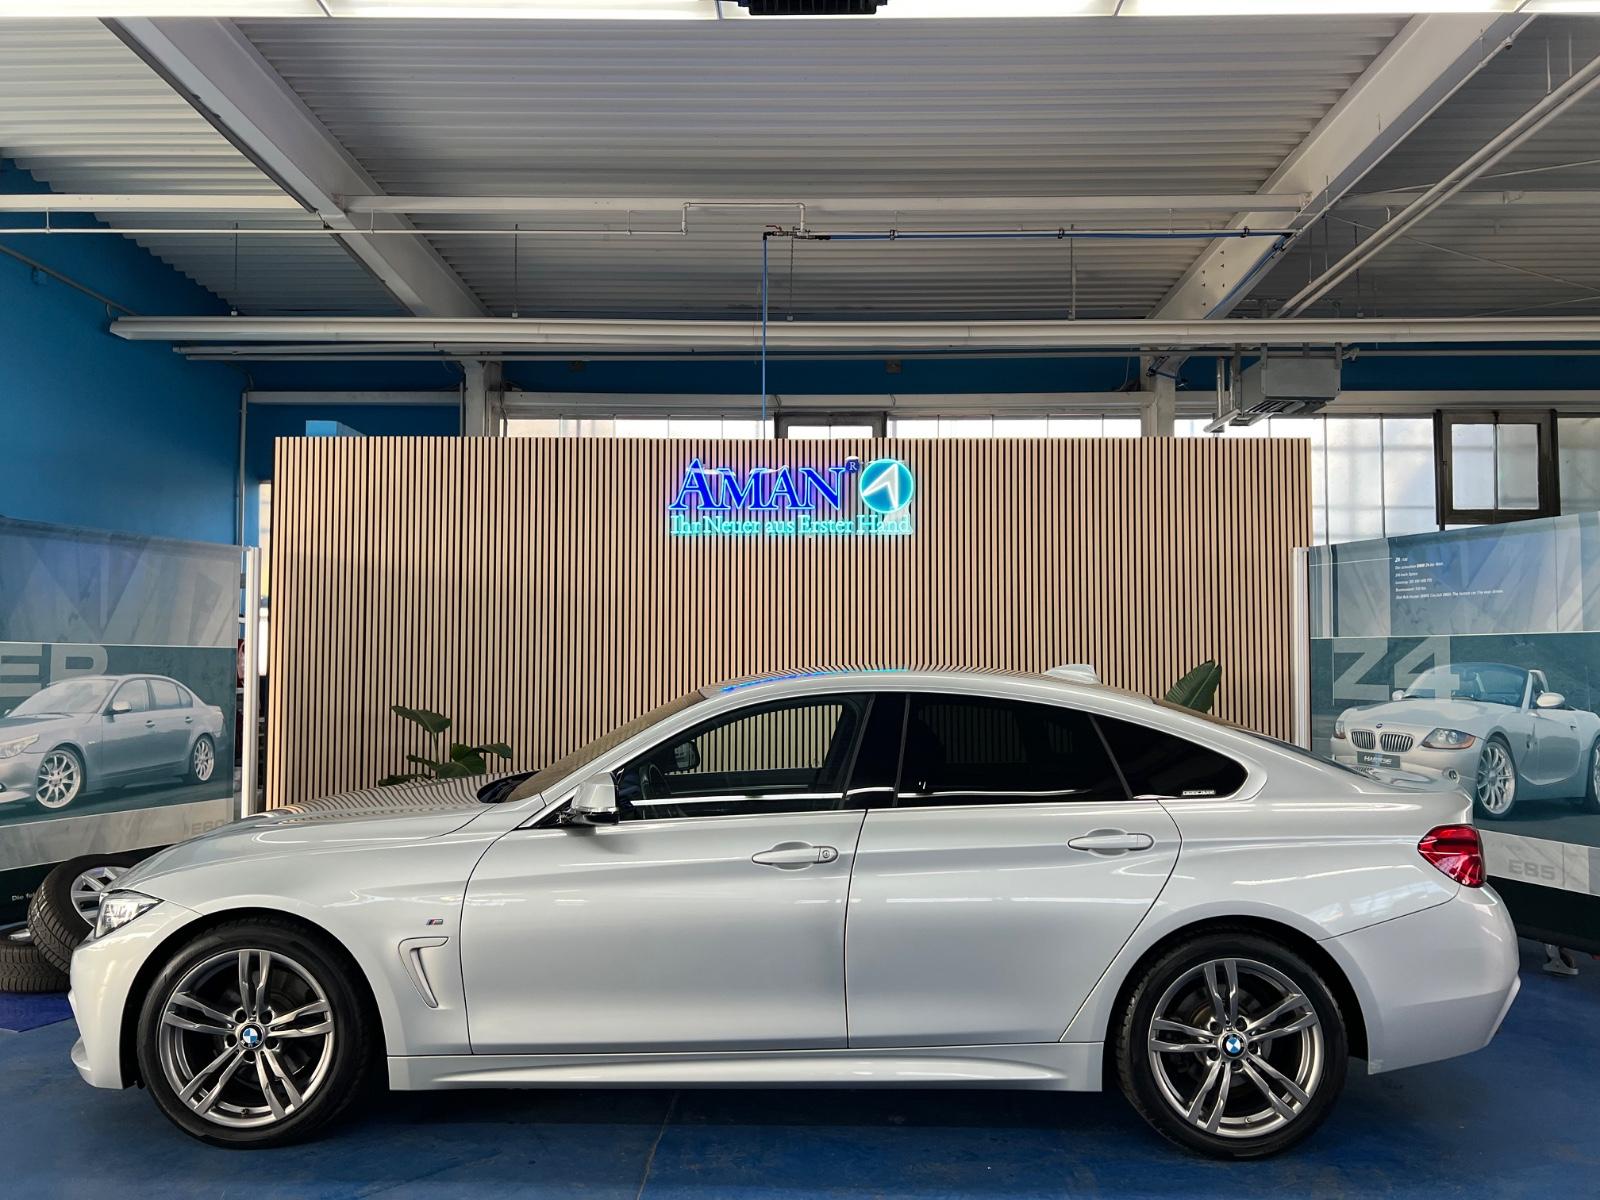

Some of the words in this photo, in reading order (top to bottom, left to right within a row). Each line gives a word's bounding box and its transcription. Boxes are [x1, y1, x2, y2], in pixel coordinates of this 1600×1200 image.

[668, 458, 846, 510] AMAN
[670, 515, 700, 535] Ihr
[703, 515, 761, 534] Neuer
[765, 519, 795, 535] aus
[798, 515, 854, 534] Erster
[1333, 637, 1460, 700] Z4
